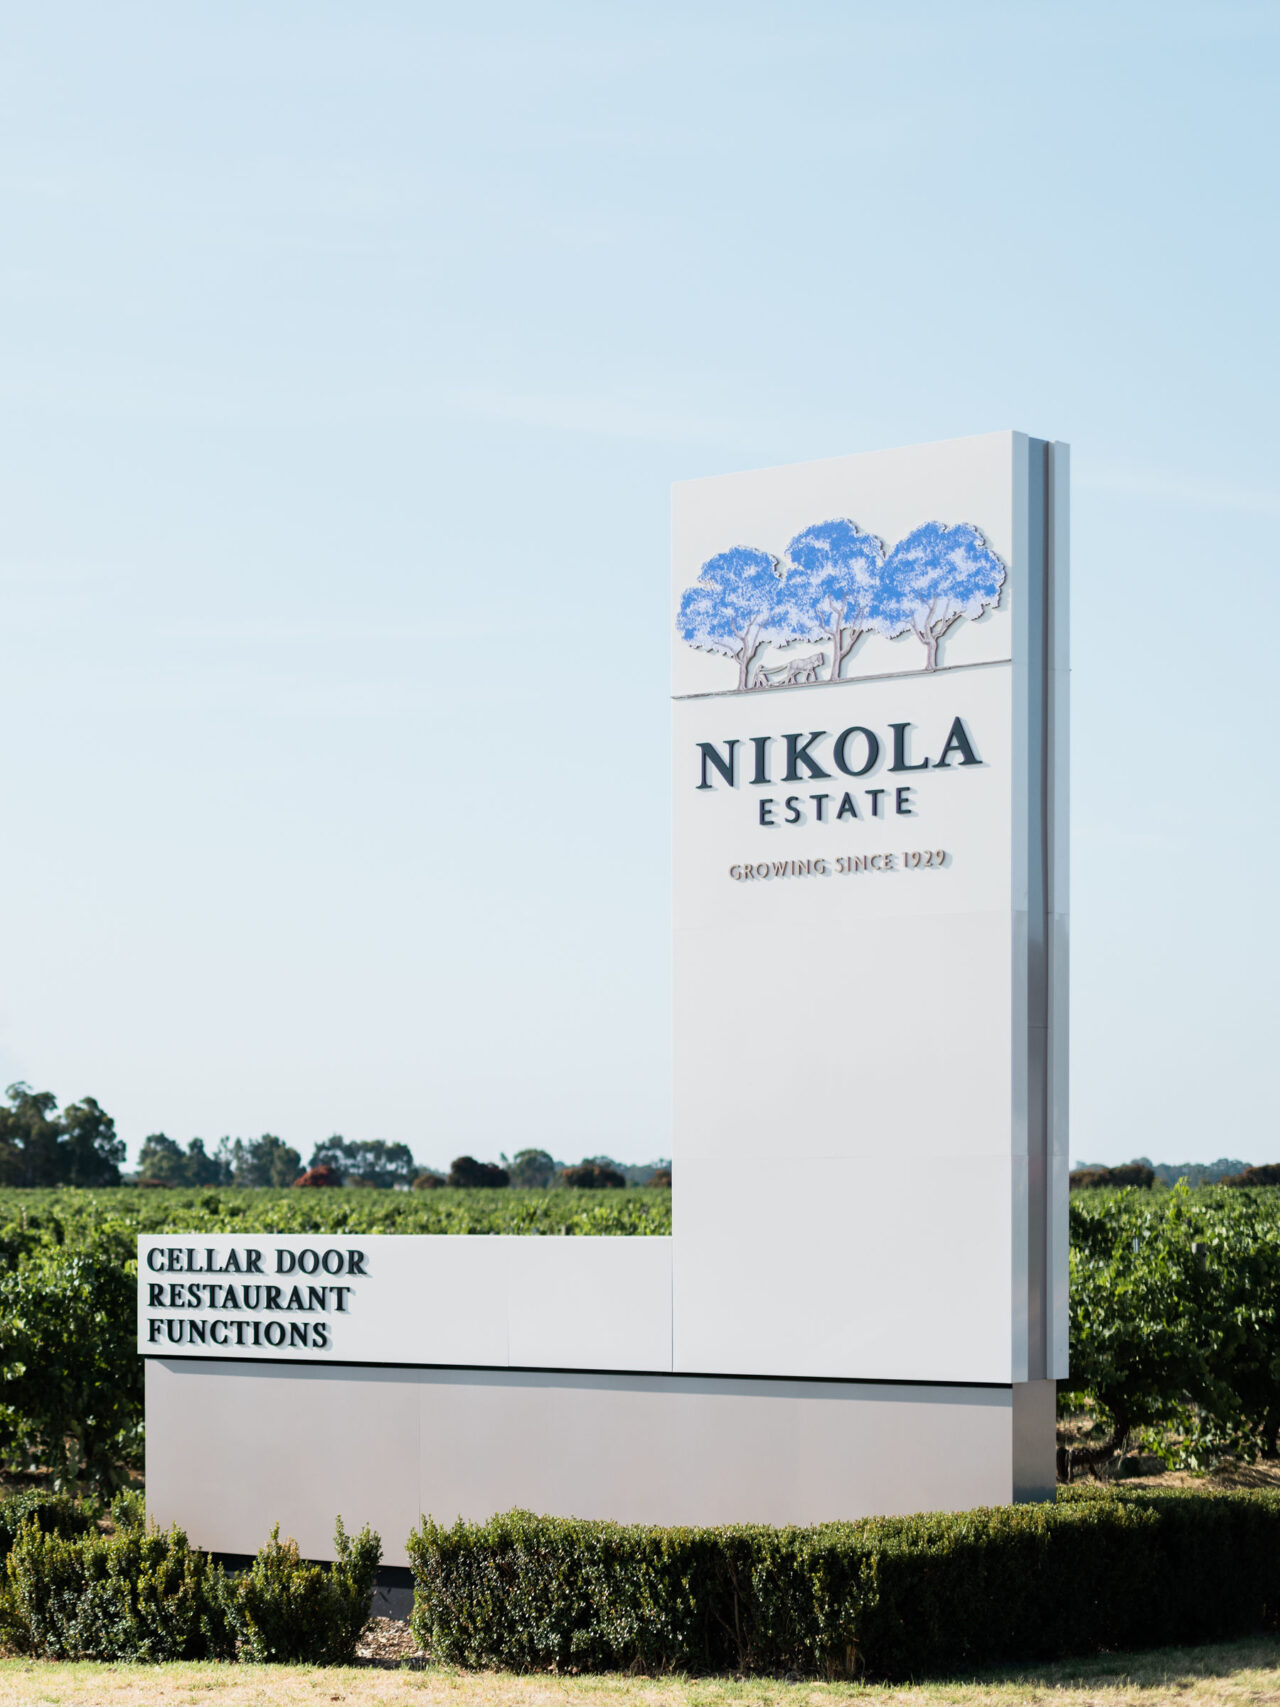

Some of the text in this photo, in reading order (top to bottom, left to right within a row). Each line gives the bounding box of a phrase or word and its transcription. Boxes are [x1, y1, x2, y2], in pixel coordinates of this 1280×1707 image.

[696, 716, 983, 789] NIKOLA
[759, 787, 912, 826] ESTATE
[729, 849, 947, 881] GROWING SINCE 1929
[147, 1247, 368, 1275] CELLAR DOOR
[147, 1283, 351, 1312] RESTAURANT
[147, 1318, 328, 1348] FUNCTIONS
